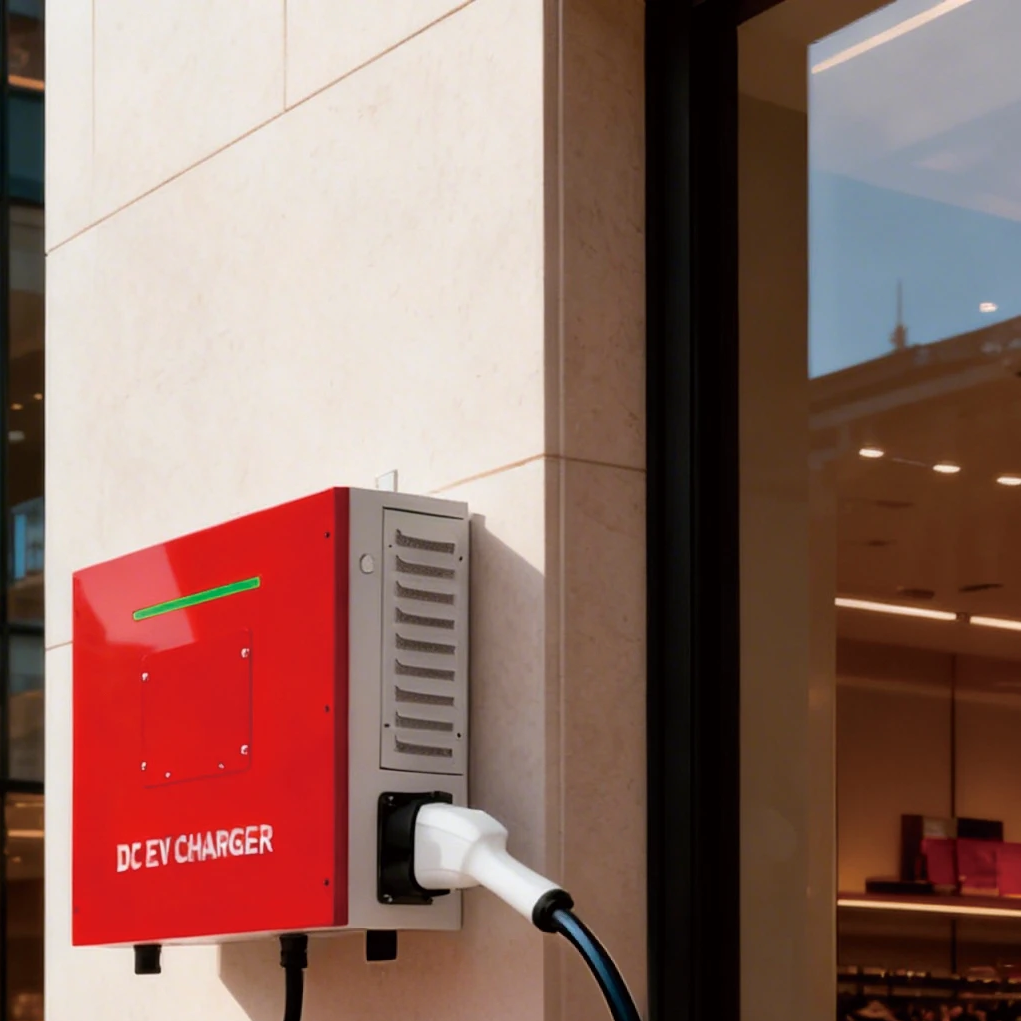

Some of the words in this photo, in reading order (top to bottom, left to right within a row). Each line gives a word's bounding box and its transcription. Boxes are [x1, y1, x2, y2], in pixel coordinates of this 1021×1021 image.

[116, 841, 142, 873] DC
[145, 836, 172, 868] EV
[174, 824, 274, 864] CHARGER
